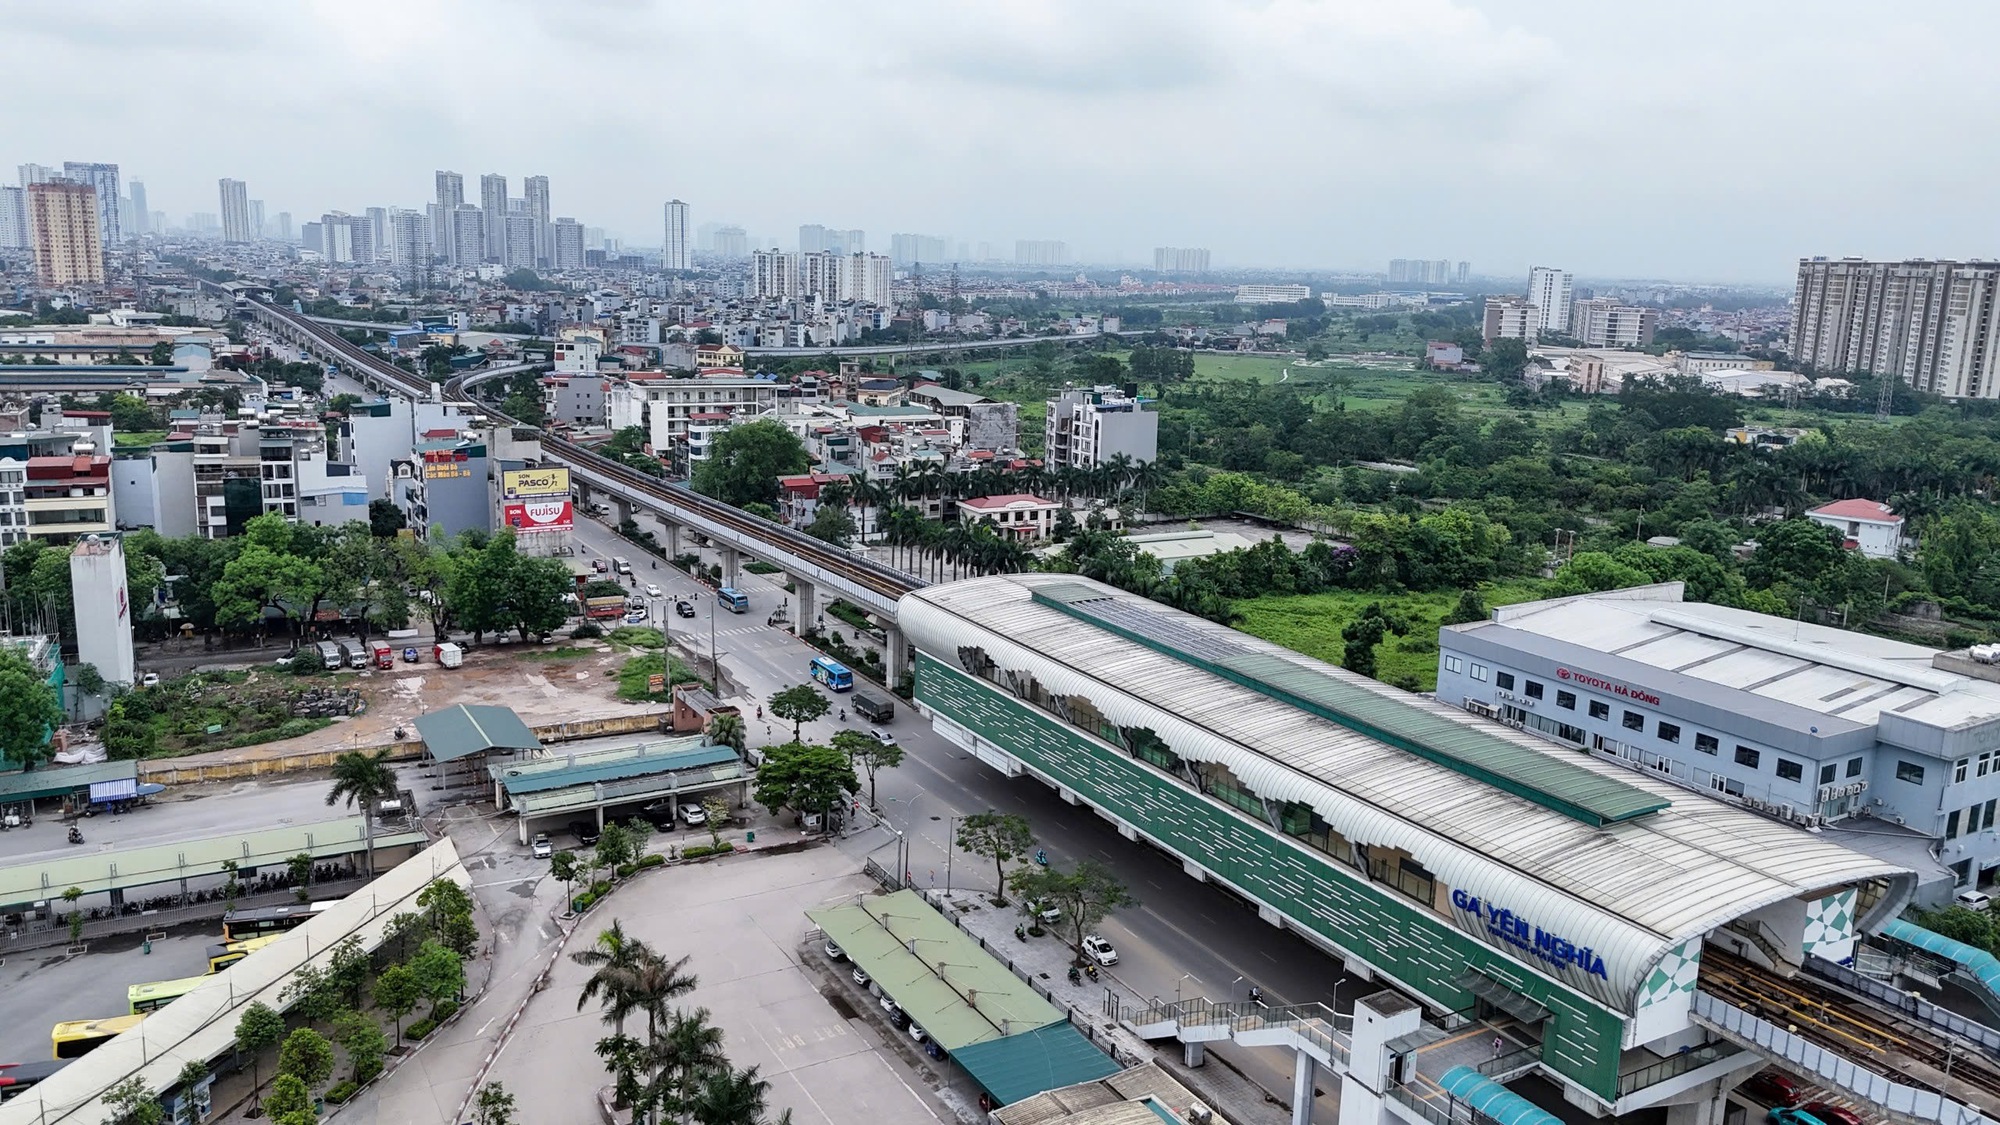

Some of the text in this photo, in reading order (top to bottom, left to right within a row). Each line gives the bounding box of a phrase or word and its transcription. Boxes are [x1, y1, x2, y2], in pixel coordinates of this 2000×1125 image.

[518, 479, 549, 487] PASCO
[1573, 672, 1660, 706] TOYOTA HÀ ĐÔNG
[1452, 889, 1608, 981] GA YÊN NGHĨA
